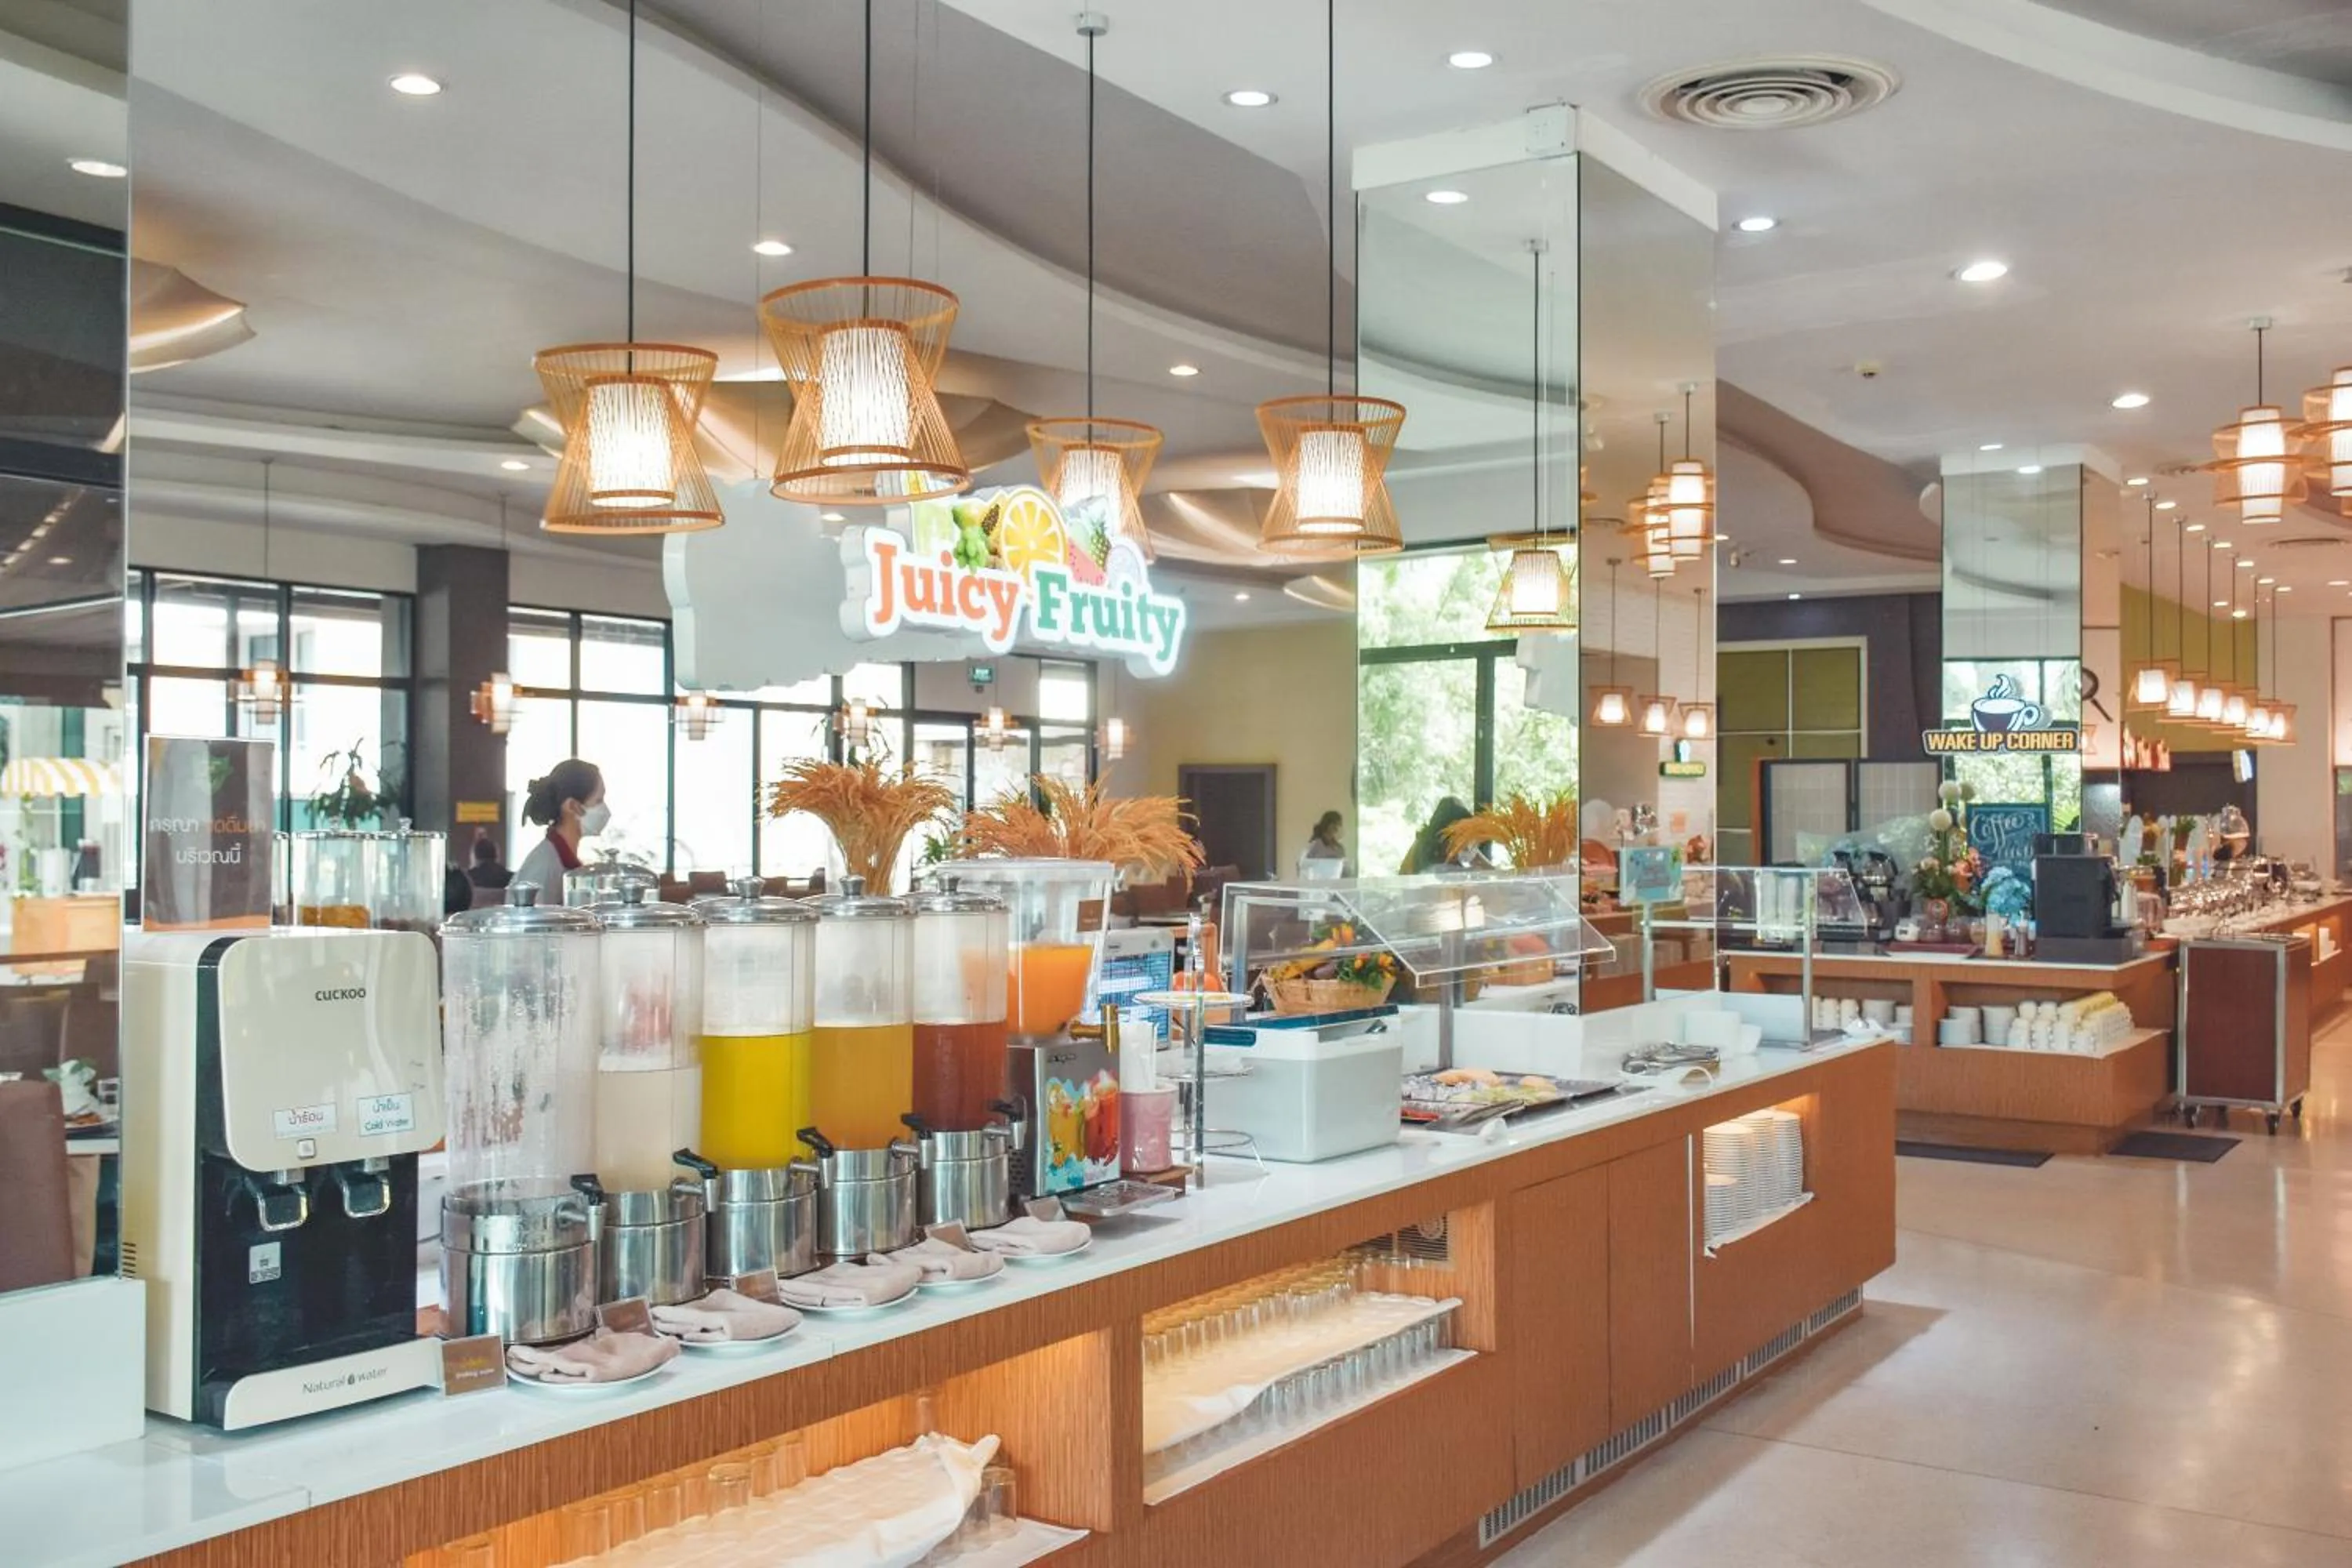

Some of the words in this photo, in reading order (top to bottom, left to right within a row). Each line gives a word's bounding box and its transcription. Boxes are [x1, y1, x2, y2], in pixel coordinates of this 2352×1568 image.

[872, 542, 1019, 642] Juicy
[1035, 569, 1180, 662] Fruity
[1927, 733, 1976, 750] WAKE
[1980, 732, 2004, 750] UP
[2006, 731, 2074, 750] CORNER
[1969, 812, 2024, 854] Coffee
[364, 1120, 383, 1131] Cold
